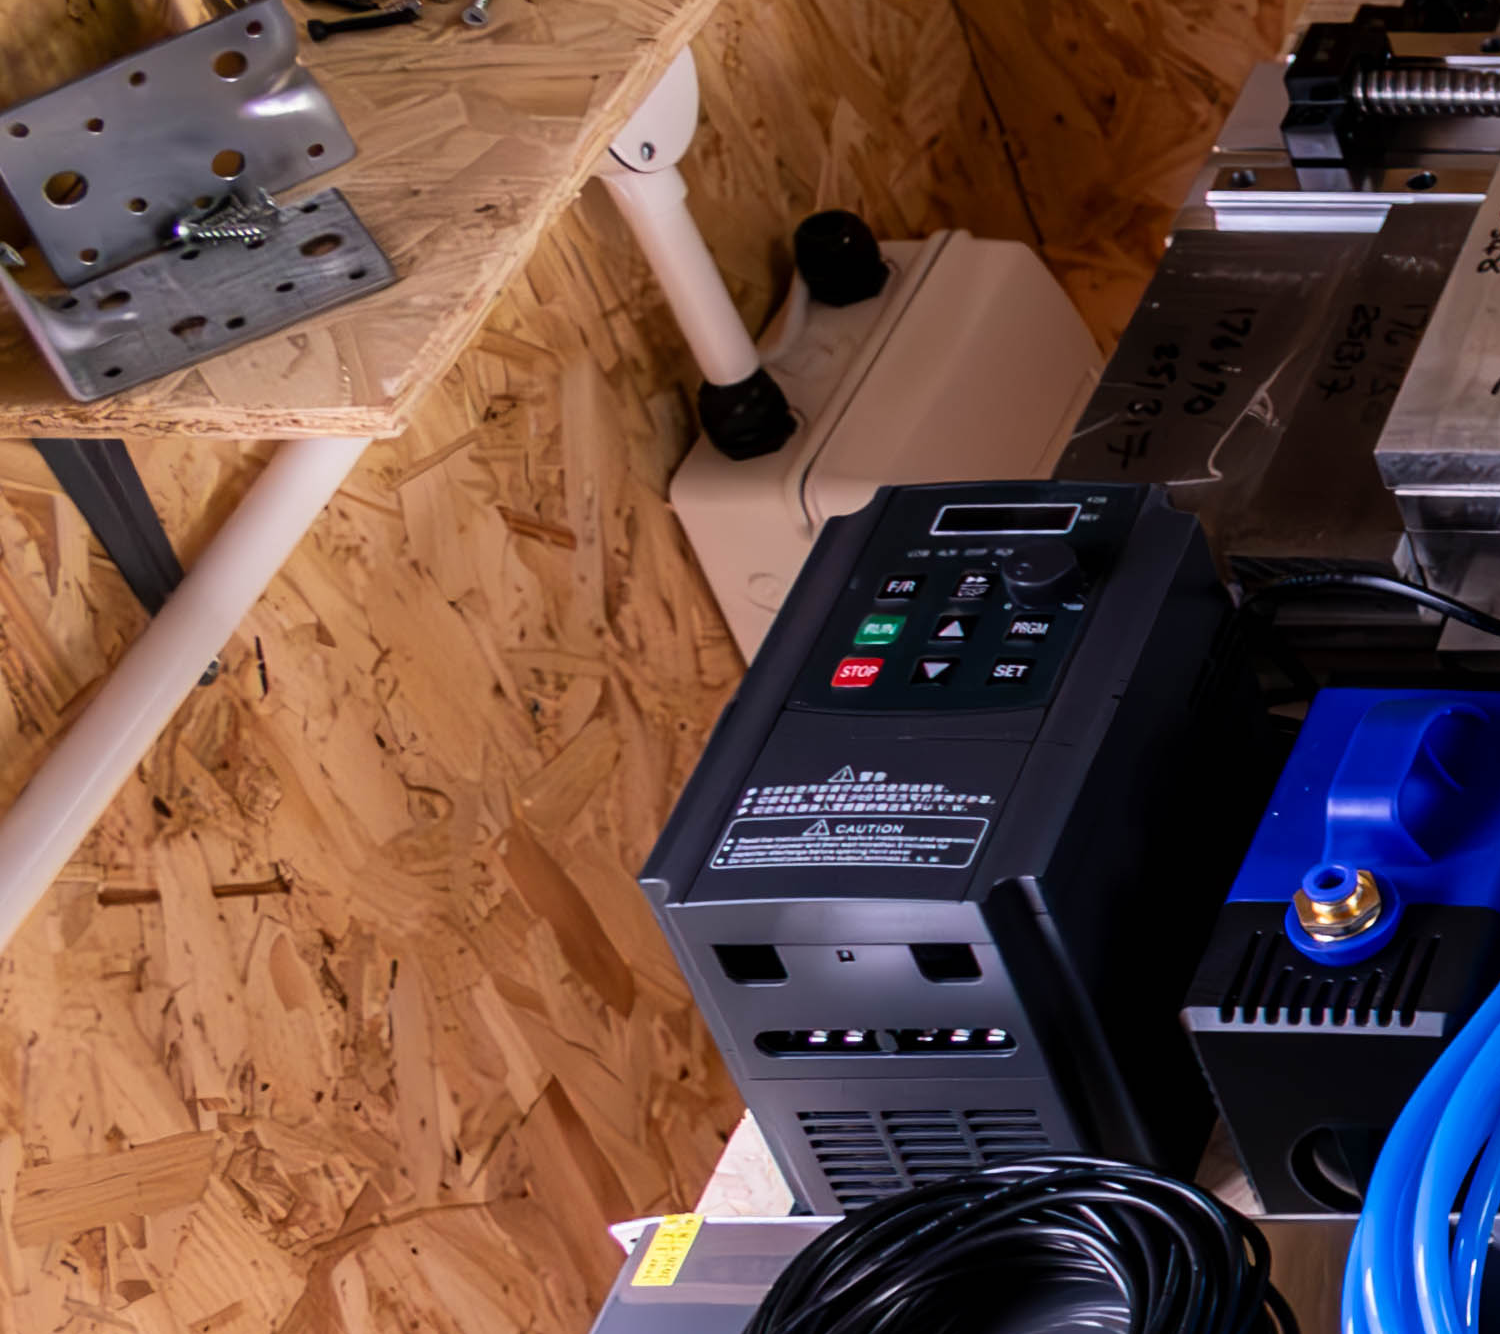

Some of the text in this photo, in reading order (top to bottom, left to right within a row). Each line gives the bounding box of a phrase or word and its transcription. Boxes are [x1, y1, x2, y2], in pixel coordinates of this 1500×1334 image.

[887, 580, 916, 593] F/R
[1011, 622, 1049, 636] PRGM
[839, 664, 879, 678] STOP
[992, 665, 1029, 678] SET
[835, 824, 905, 835] CAUTION
